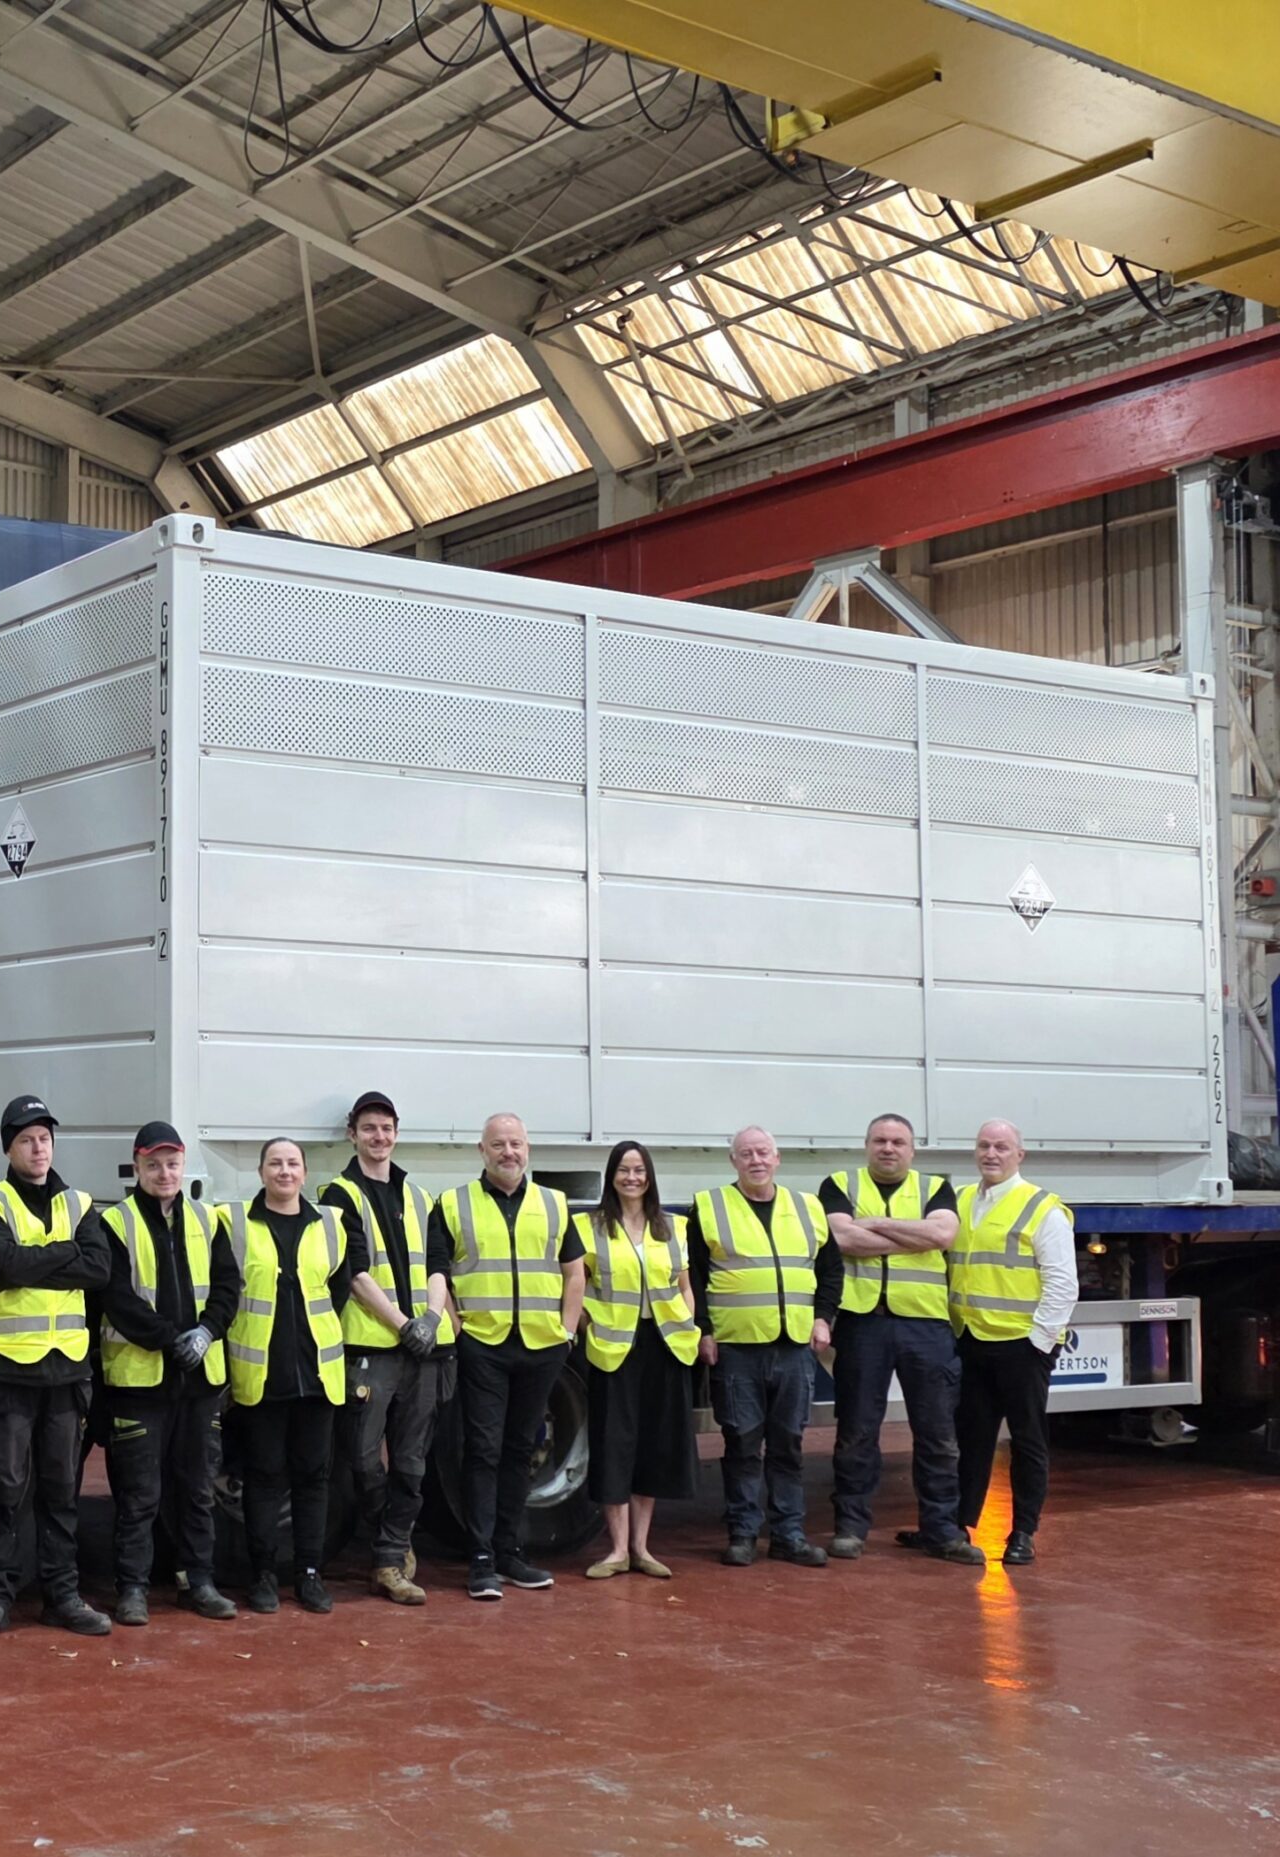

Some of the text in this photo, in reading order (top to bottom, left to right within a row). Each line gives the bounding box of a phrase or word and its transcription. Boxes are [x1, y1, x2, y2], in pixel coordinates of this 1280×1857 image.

[160, 601, 168, 959] GHMU 891710 2
[1203, 738, 1212, 826] GHMU
[8, 843, 27, 861] 2794
[1206, 836, 1217, 969] 891710
[1212, 1034, 1222, 1124] 22G2
[1140, 1306, 1176, 1316] DENNISON
[1057, 1356, 1109, 1371] ERTSON
